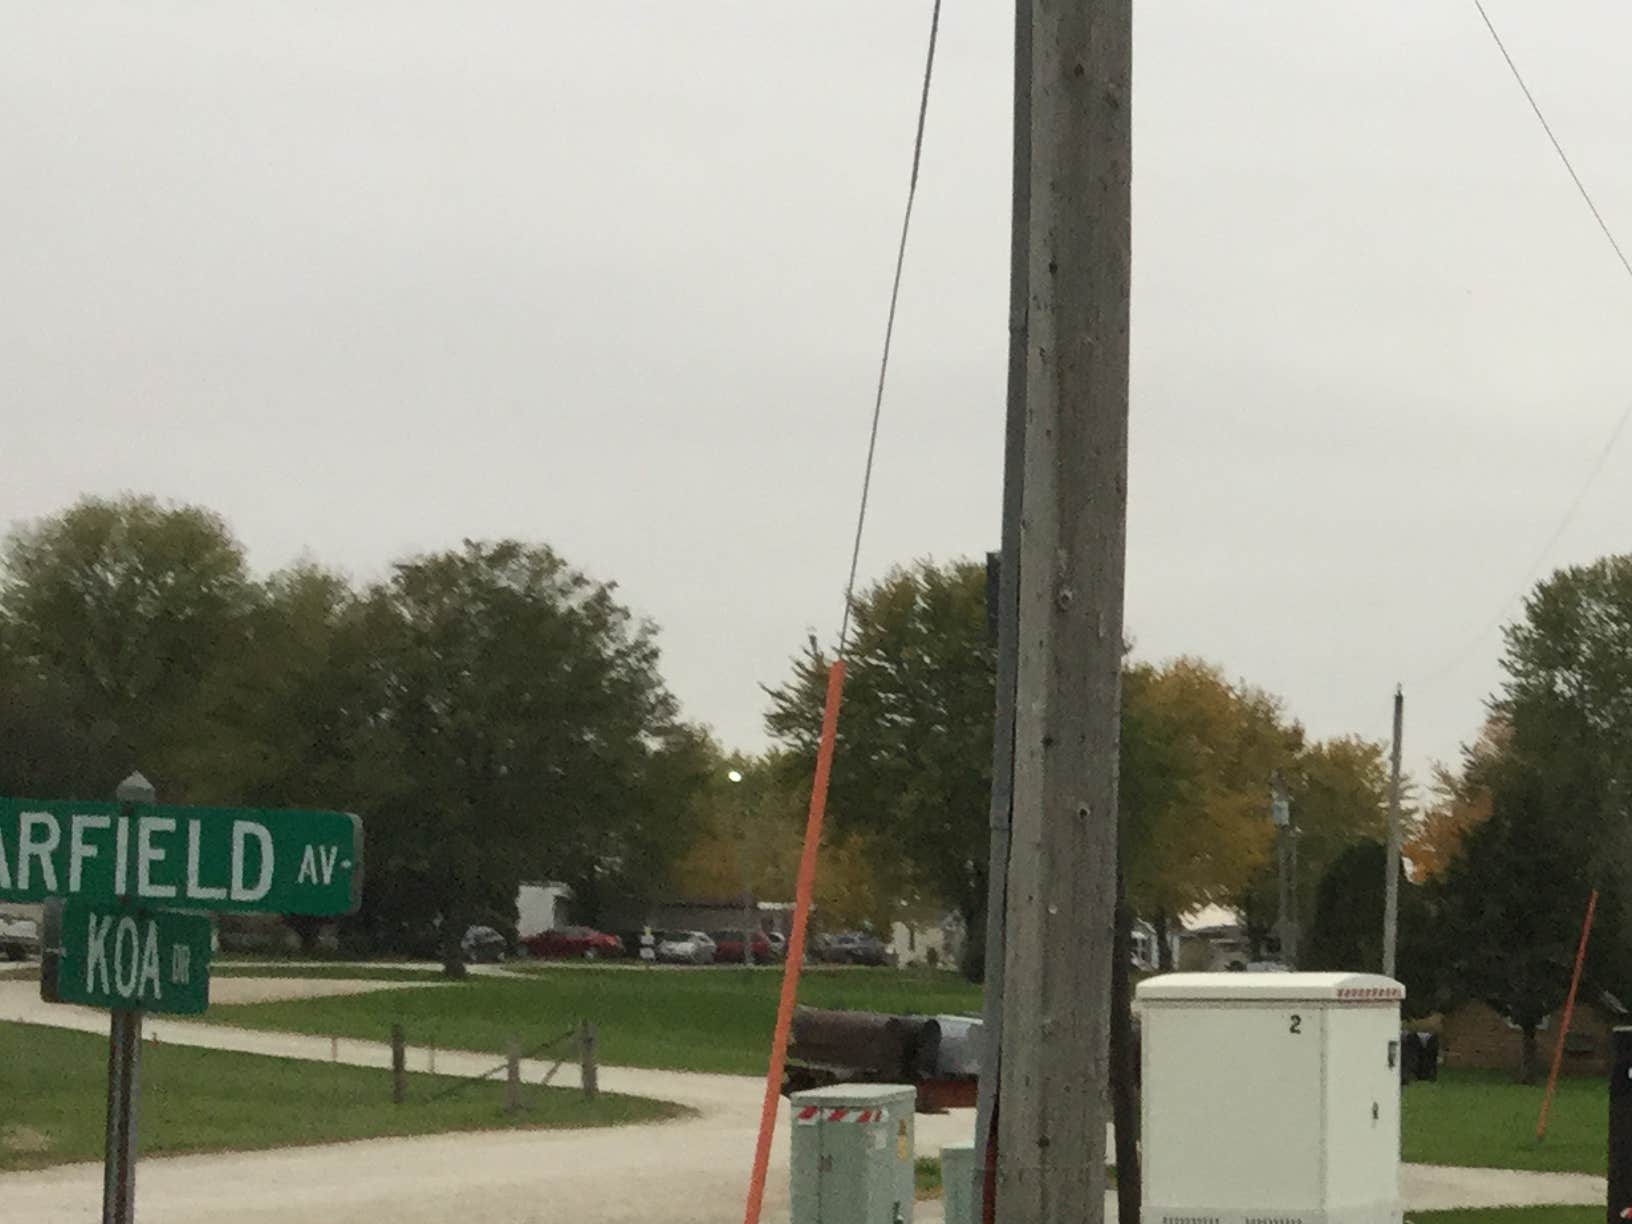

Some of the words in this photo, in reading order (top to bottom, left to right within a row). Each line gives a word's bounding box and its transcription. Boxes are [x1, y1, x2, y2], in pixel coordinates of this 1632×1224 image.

[298, 844, 338, 885] AV
[86, 912, 162, 1000] KOA
[1289, 1014, 1302, 1035] 2
